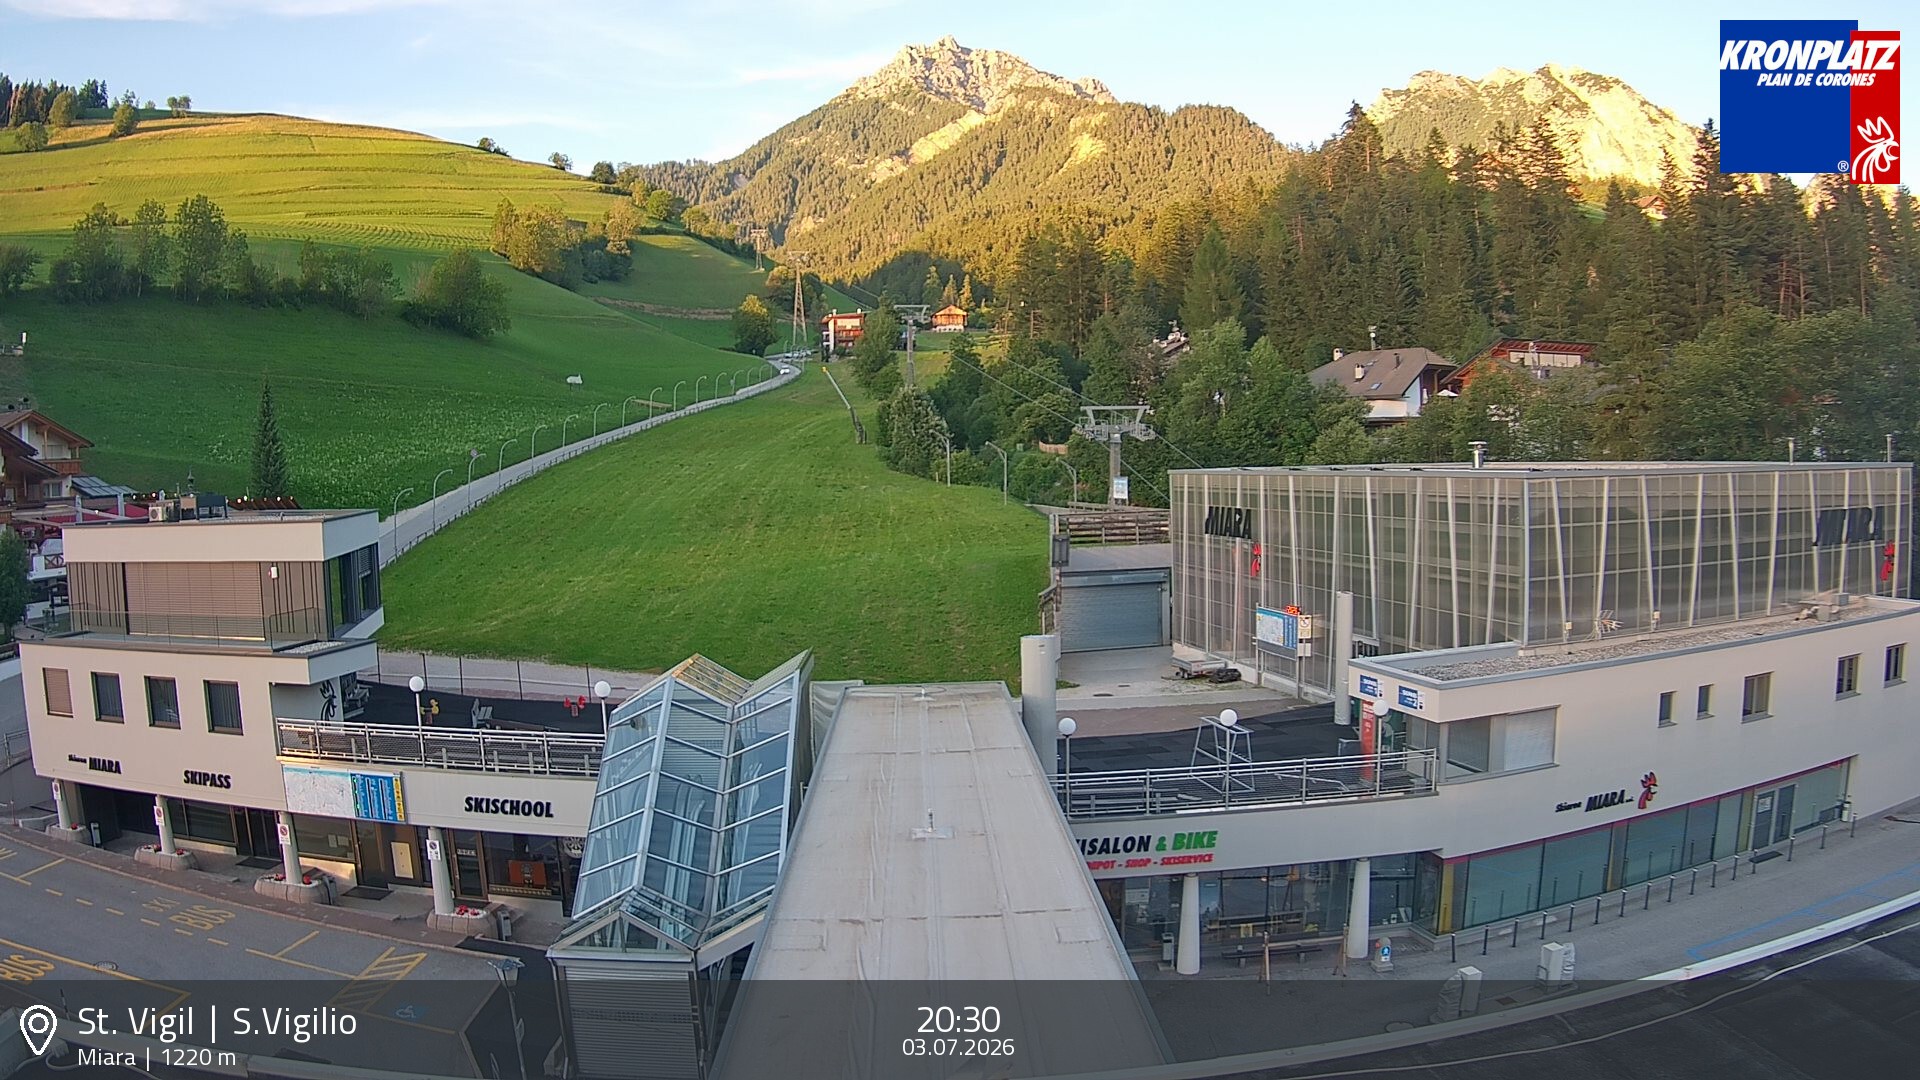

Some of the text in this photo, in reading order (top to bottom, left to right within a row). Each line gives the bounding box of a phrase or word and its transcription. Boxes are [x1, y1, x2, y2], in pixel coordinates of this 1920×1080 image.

[1205, 506, 1252, 539] MIARA
[88, 757, 122, 775] MIARA
[183, 770, 232, 789] SKIPASS
[464, 796, 554, 818] SKISCHOOL
[1584, 789, 1626, 812] MIARA
[1155, 836, 1168, 852] &
[1171, 830, 1219, 851] BIKE
[1125, 858, 1152, 869] SHOP
[168, 905, 236, 930] BUS
[0, 954, 55, 985] BUS
